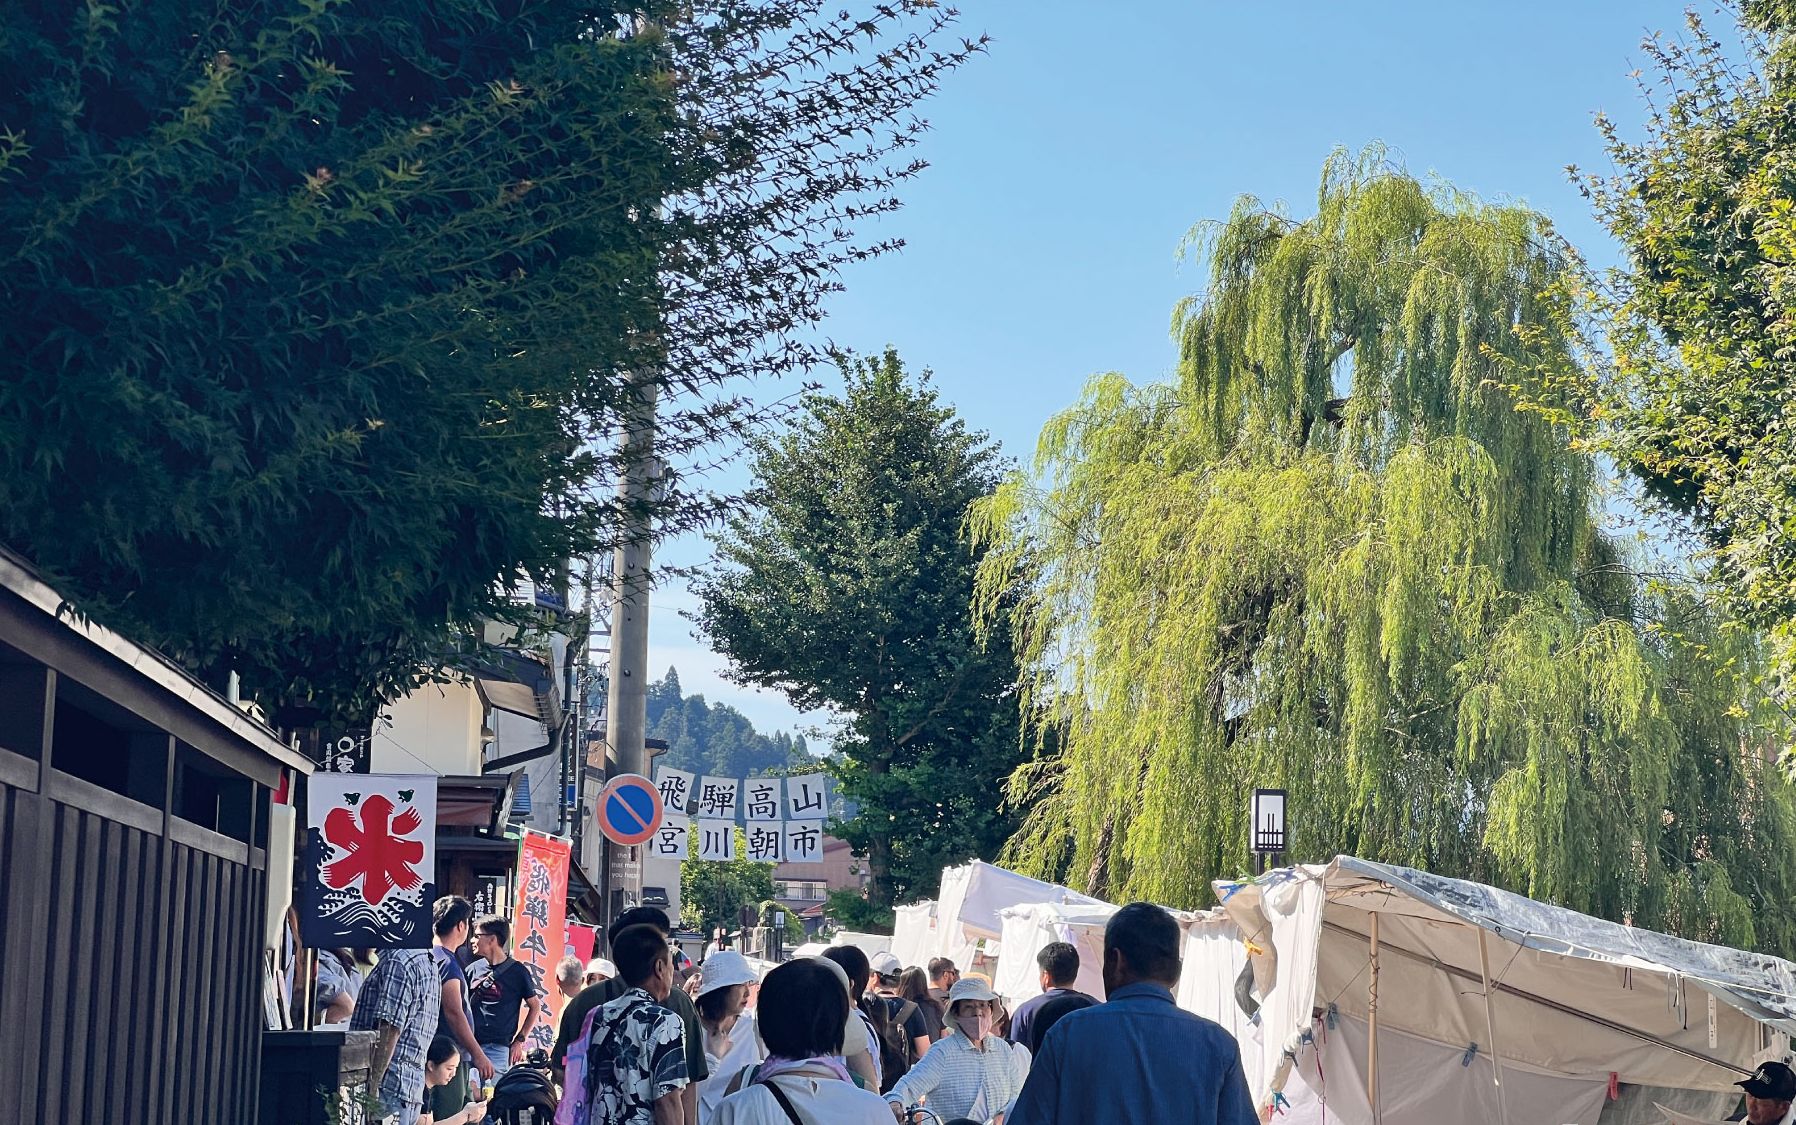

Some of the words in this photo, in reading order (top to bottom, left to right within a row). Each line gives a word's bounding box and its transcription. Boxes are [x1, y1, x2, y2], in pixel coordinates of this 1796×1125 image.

[658, 775, 822, 819] 飛騨高山
[658, 821, 820, 860] 宮川朝市
